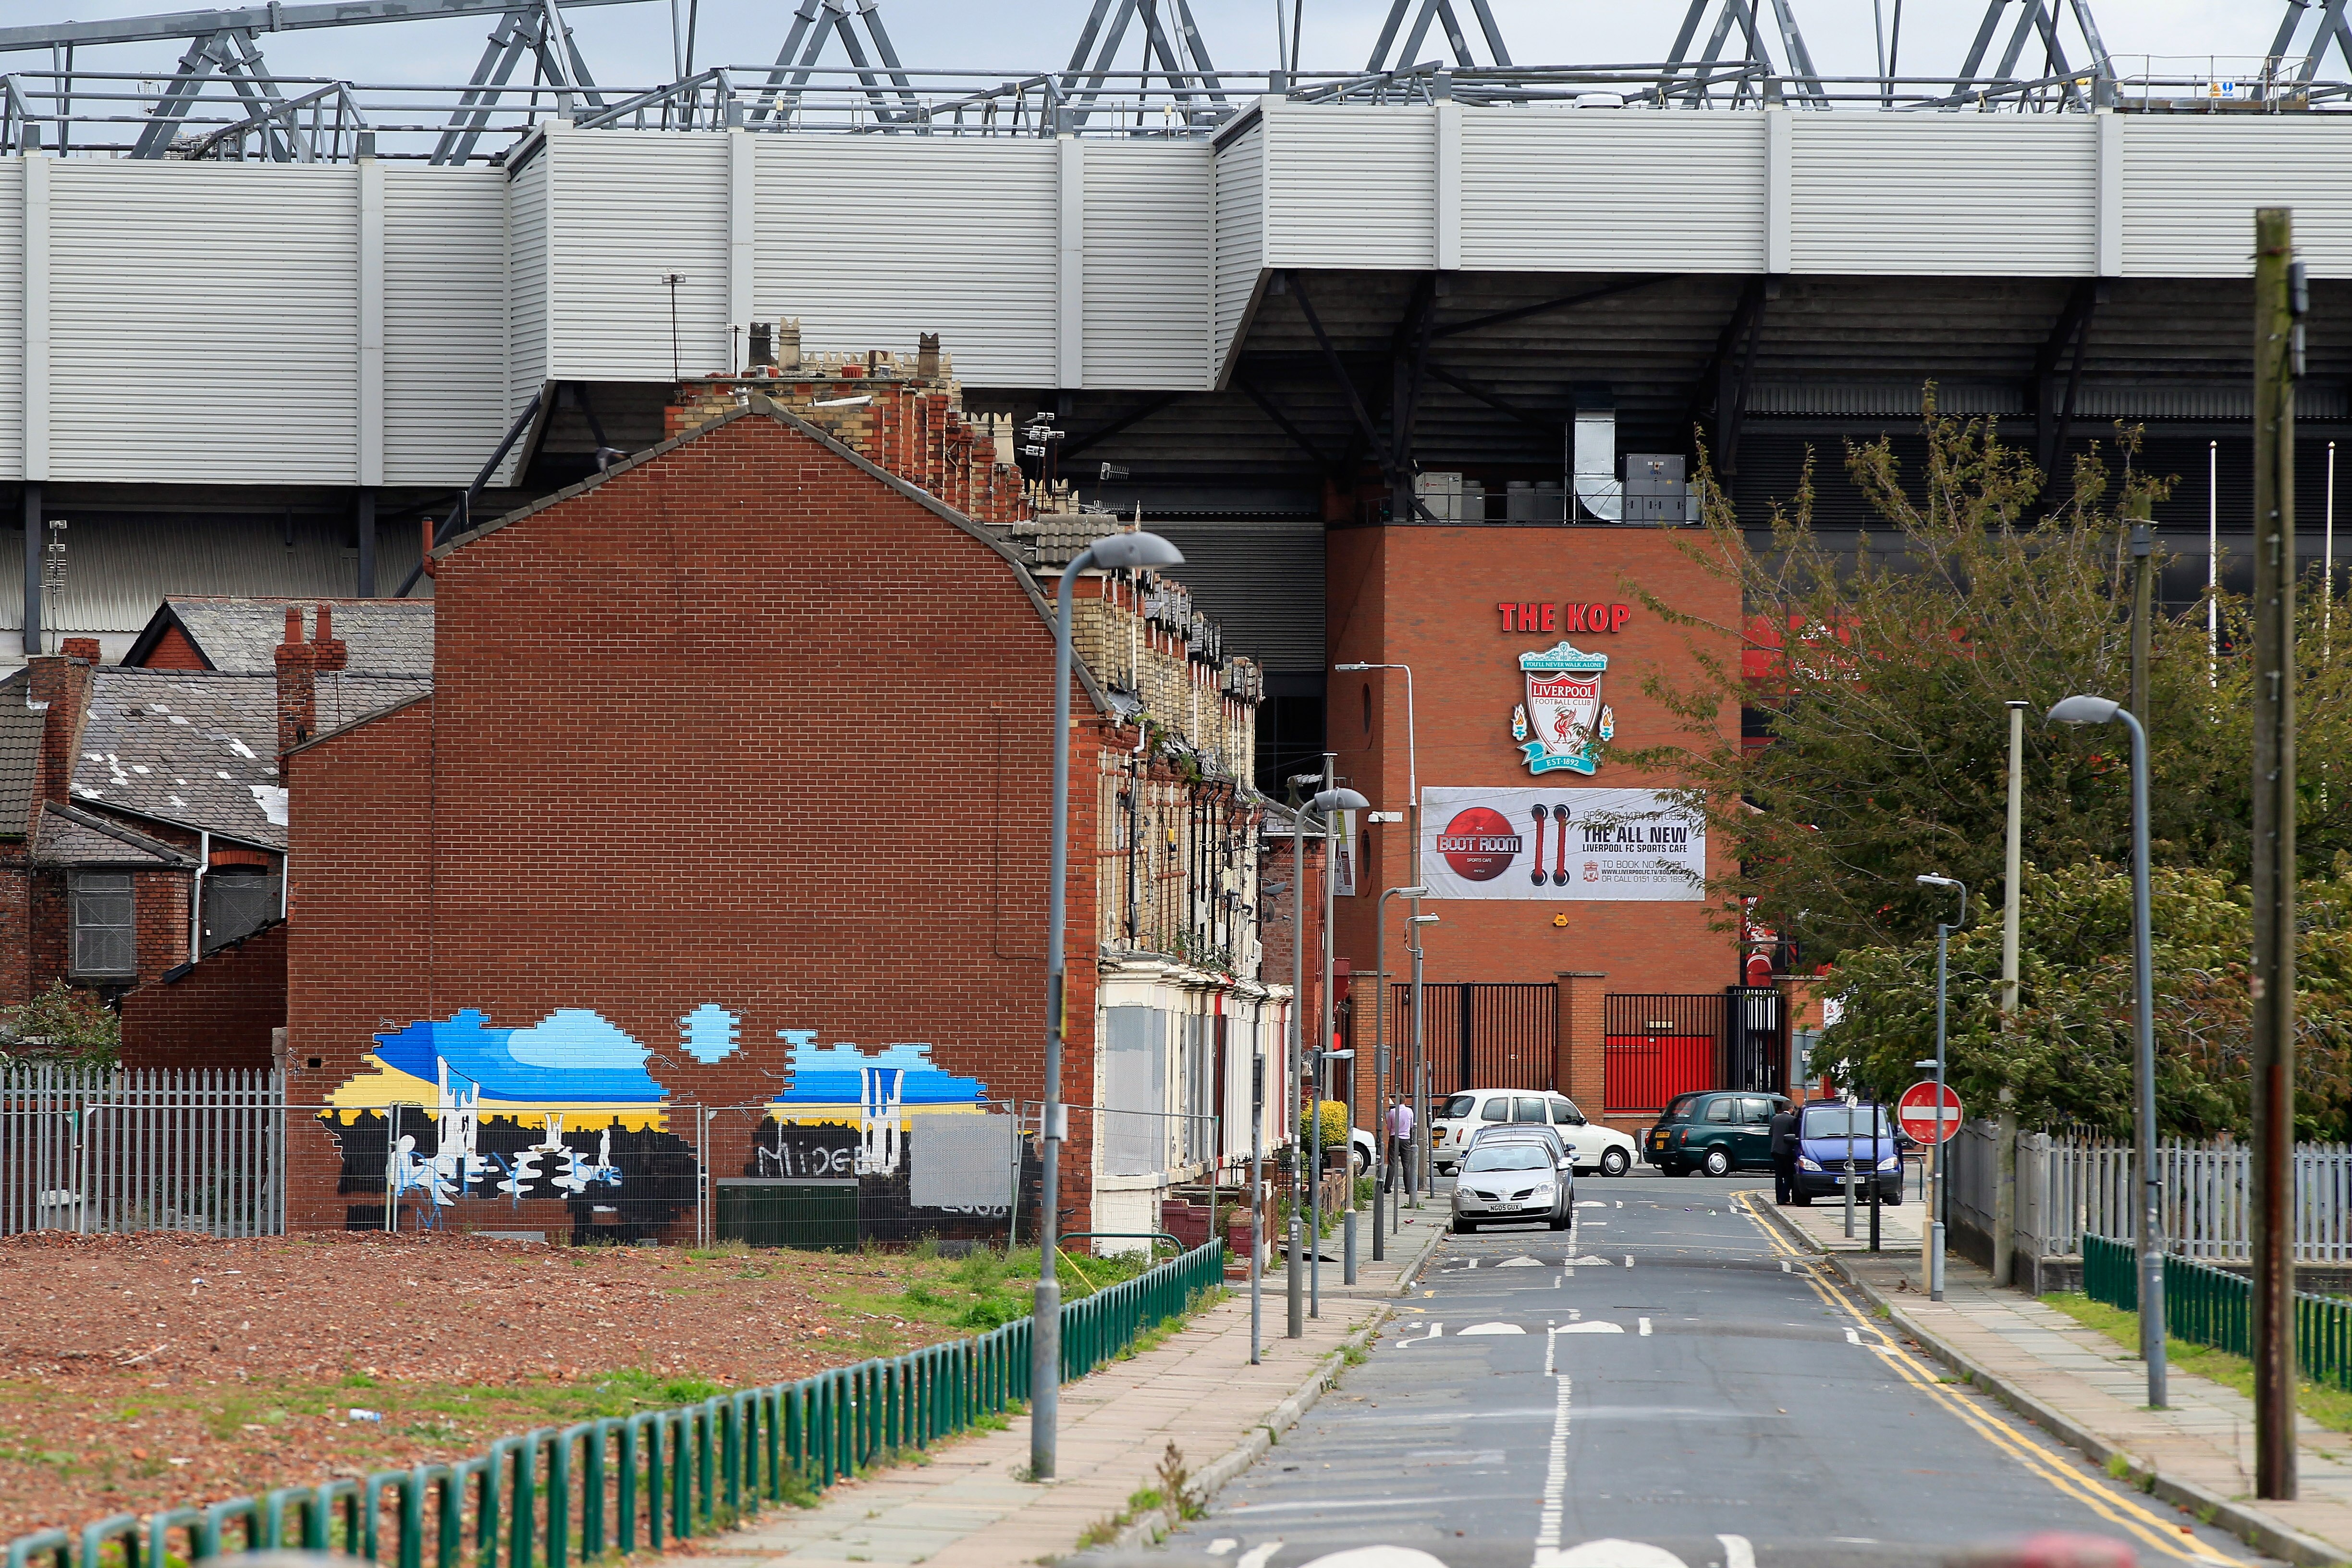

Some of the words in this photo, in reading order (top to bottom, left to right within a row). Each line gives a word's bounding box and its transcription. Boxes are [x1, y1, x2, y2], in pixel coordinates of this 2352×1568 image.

[1499, 603, 1555, 631] THE
[1567, 603, 1630, 632] KOP
[1533, 685, 1594, 697] LIVERPOOL
[1583, 811, 1620, 820] OPENING
[1624, 811, 1645, 820] 14TH
[1647, 812, 1687, 820] OCTOBE
[1584, 827, 1611, 843] THE
[1617, 827, 1643, 843] ALL
[1650, 827, 1687, 843] NEW
[1440, 837, 1476, 851] BOOT
[1479, 837, 1519, 851] ROOM
[1626, 844, 1634, 852] FC
